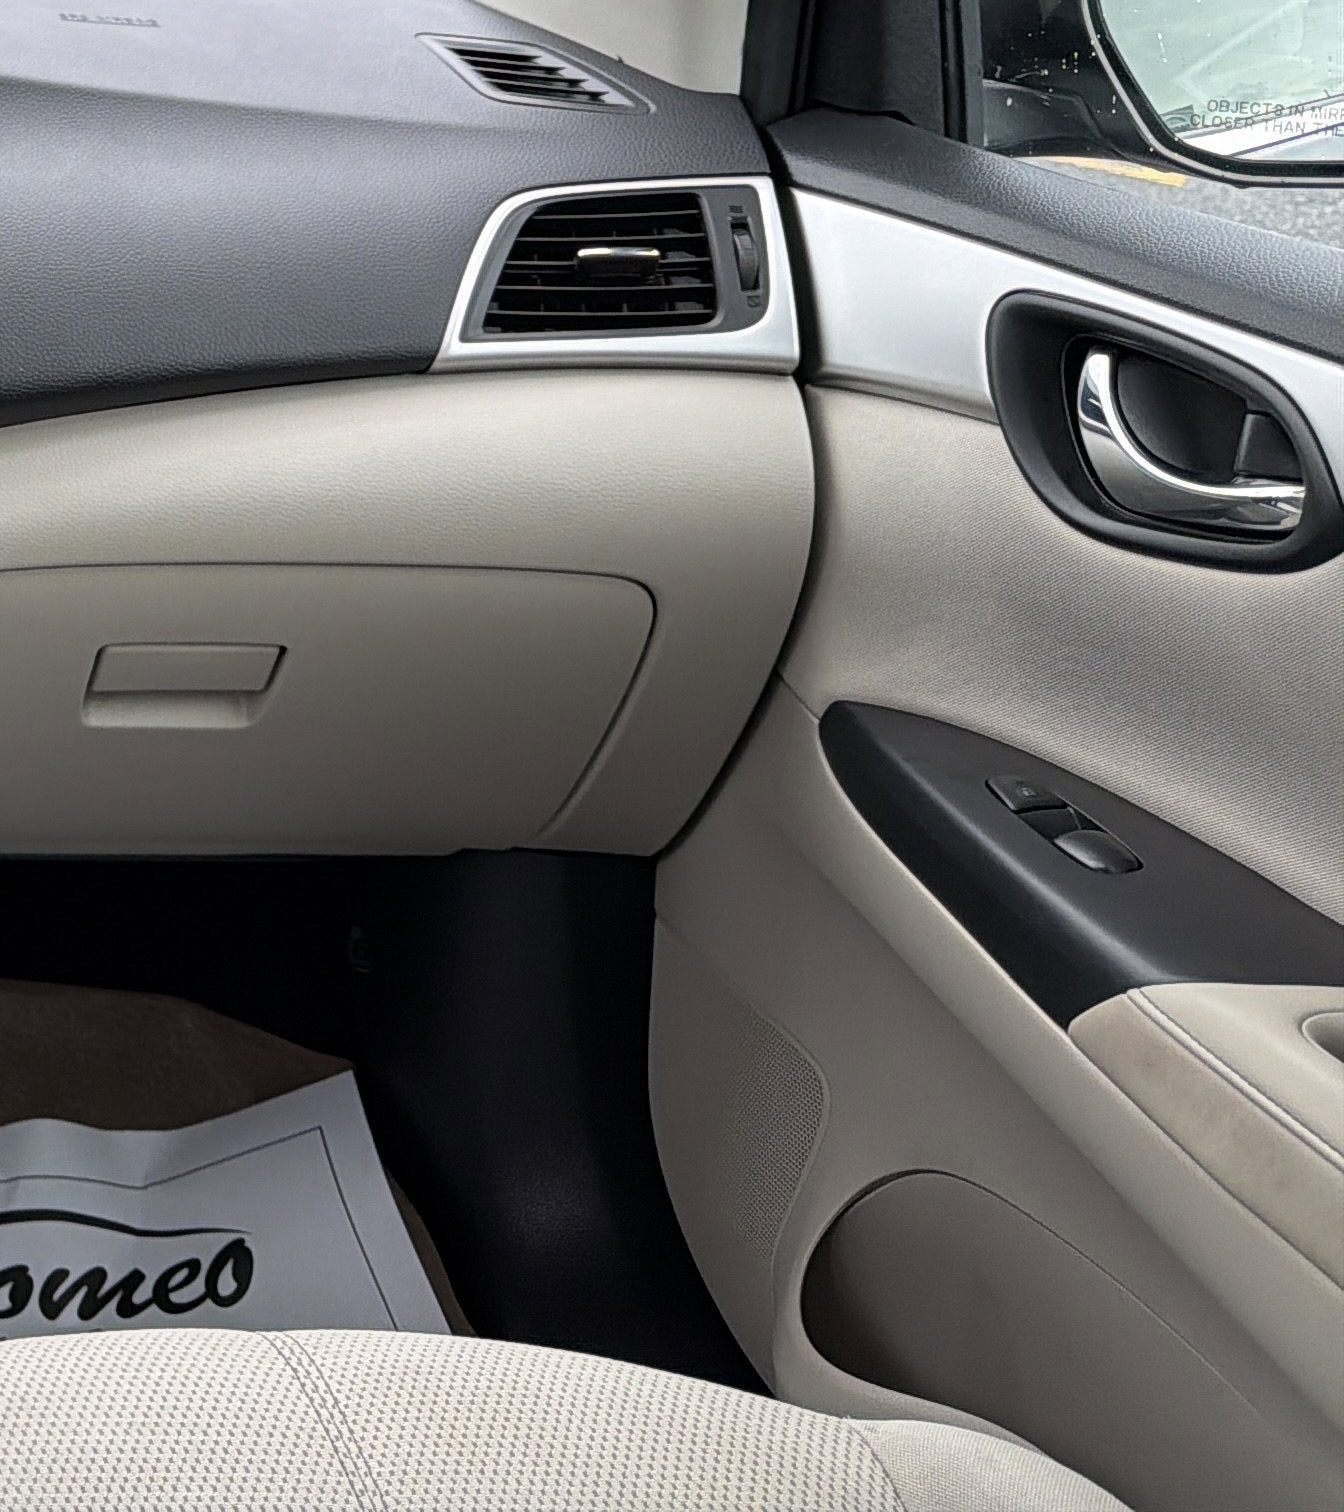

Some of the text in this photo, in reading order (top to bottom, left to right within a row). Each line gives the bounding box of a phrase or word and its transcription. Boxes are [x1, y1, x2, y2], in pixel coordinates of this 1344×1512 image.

[1207, 99, 1285, 117] OBJECTS
[1289, 105, 1305, 116] IN
[1190, 113, 1256, 129] CLOSER
[1264, 119, 1306, 135] THAN
